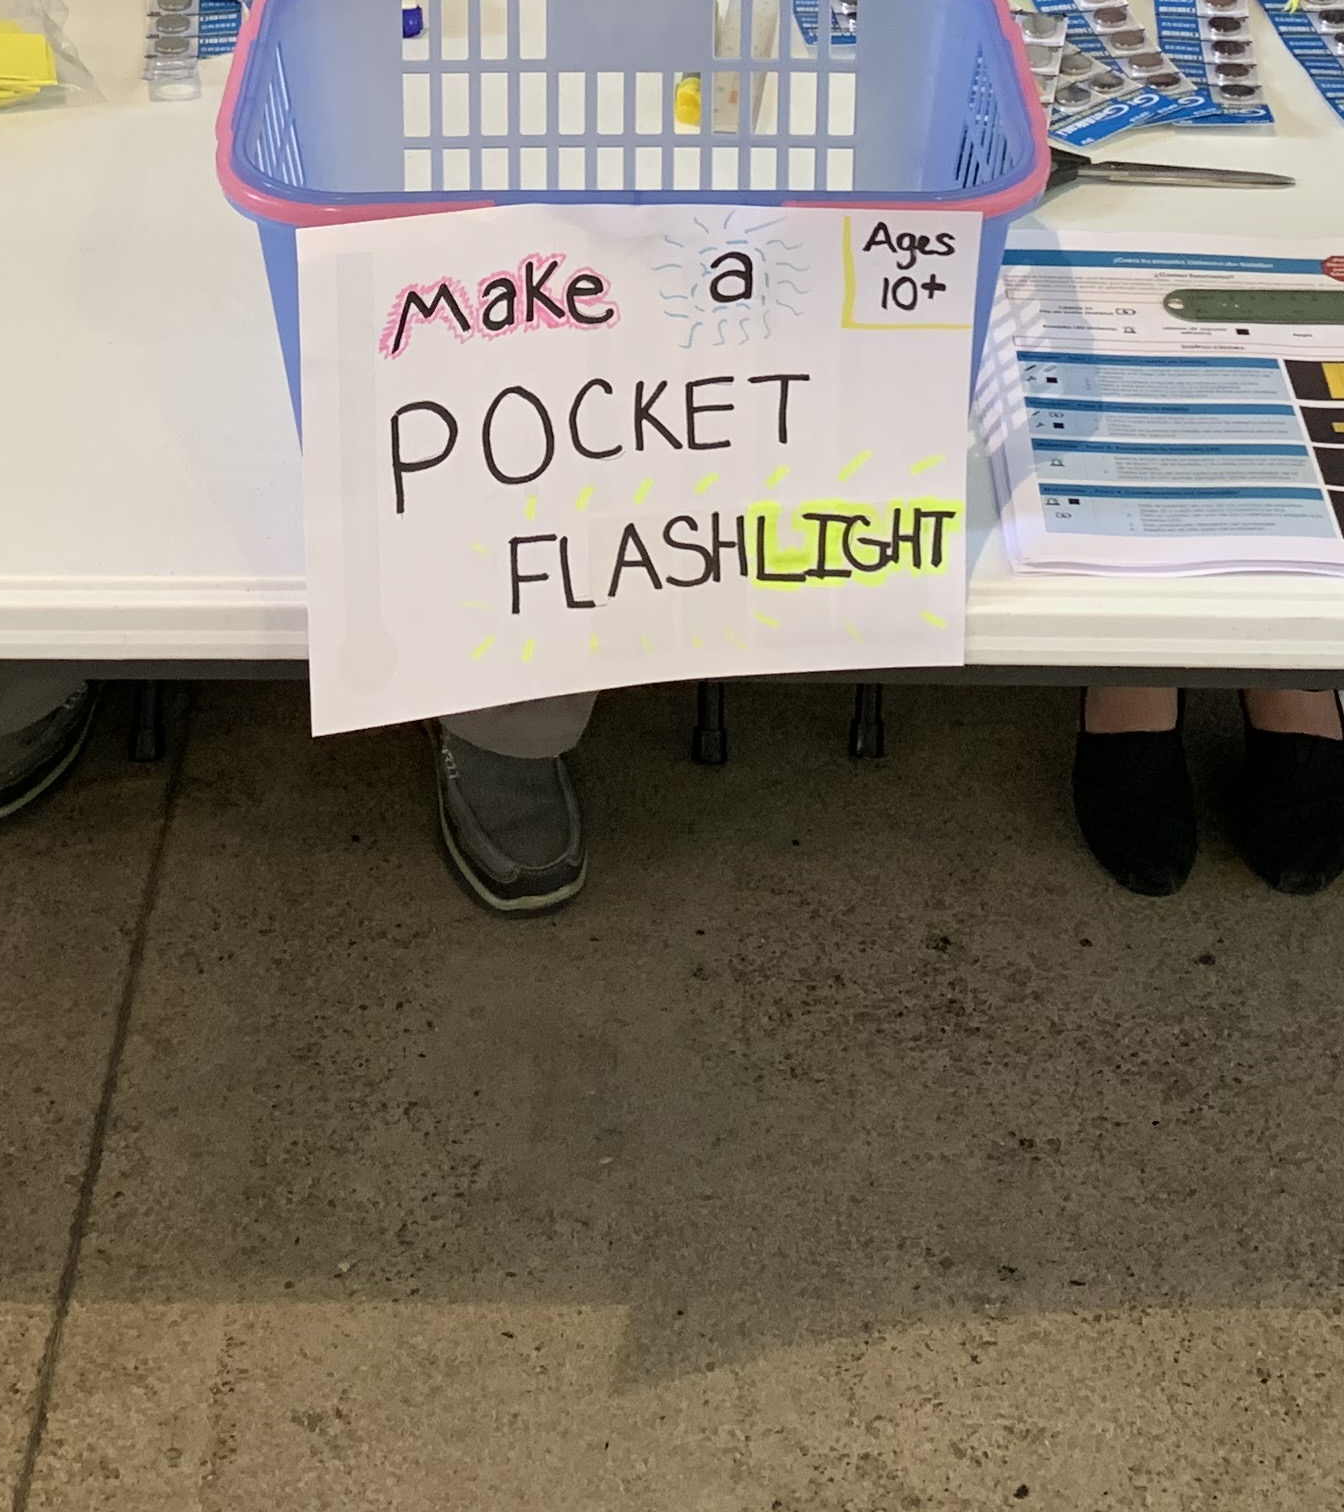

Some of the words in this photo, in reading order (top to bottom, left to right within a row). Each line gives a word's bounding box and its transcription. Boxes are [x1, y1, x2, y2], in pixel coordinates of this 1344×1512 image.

[863, 221, 957, 271] Ages
[709, 251, 754, 304] a
[880, 273, 948, 311] 10+
[391, 374, 811, 515] POCKET
[508, 507, 956, 616] FLASHLIGHT
